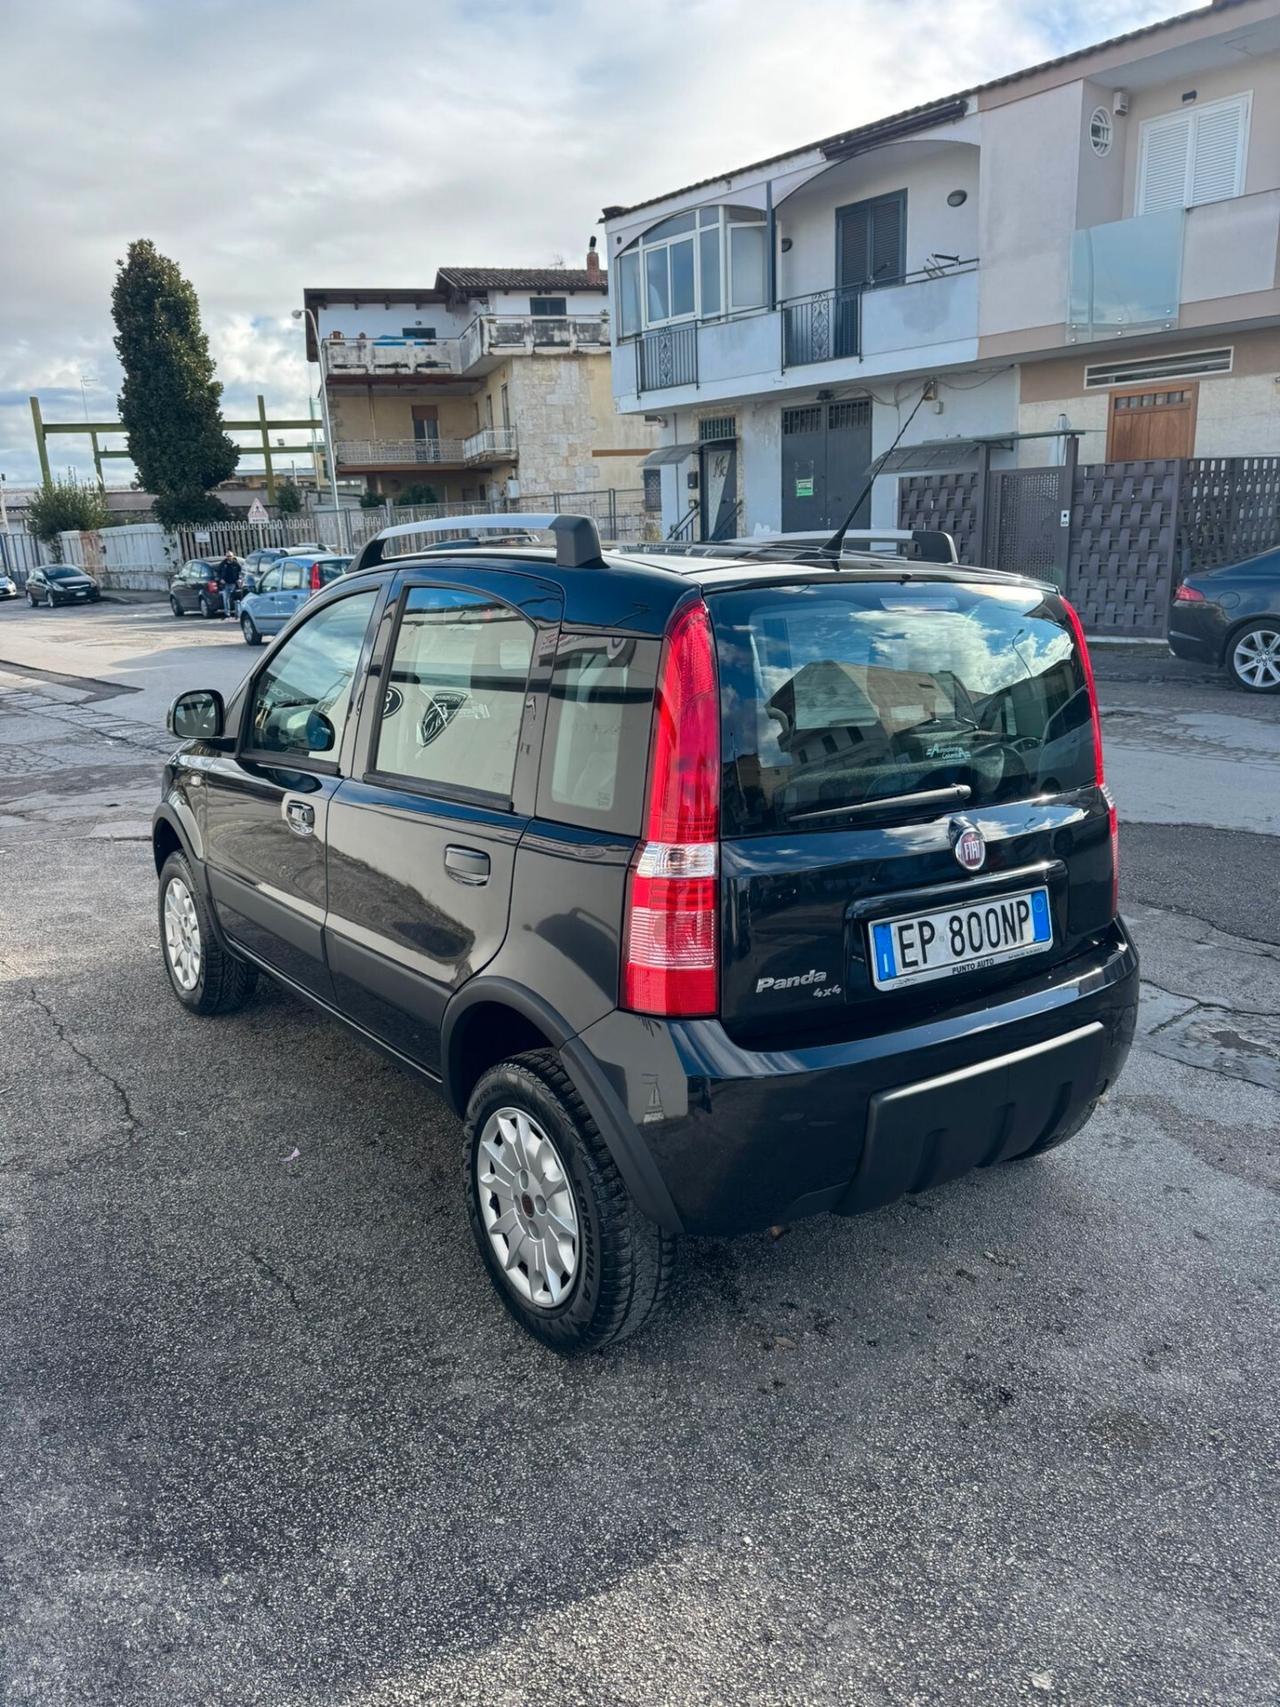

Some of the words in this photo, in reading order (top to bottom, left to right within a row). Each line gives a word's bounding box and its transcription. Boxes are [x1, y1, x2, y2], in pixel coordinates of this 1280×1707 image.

[963, 840, 981, 861] FIAT
[897, 920, 936, 969] EP
[949, 900, 1030, 957] 800NP
[952, 963, 976, 975] PUNTO
[977, 958, 995, 969] AUTO
[756, 969, 827, 993] Panda
[813, 984, 842, 998] 4x4
[575, 1179, 596, 1303] FORMULA
